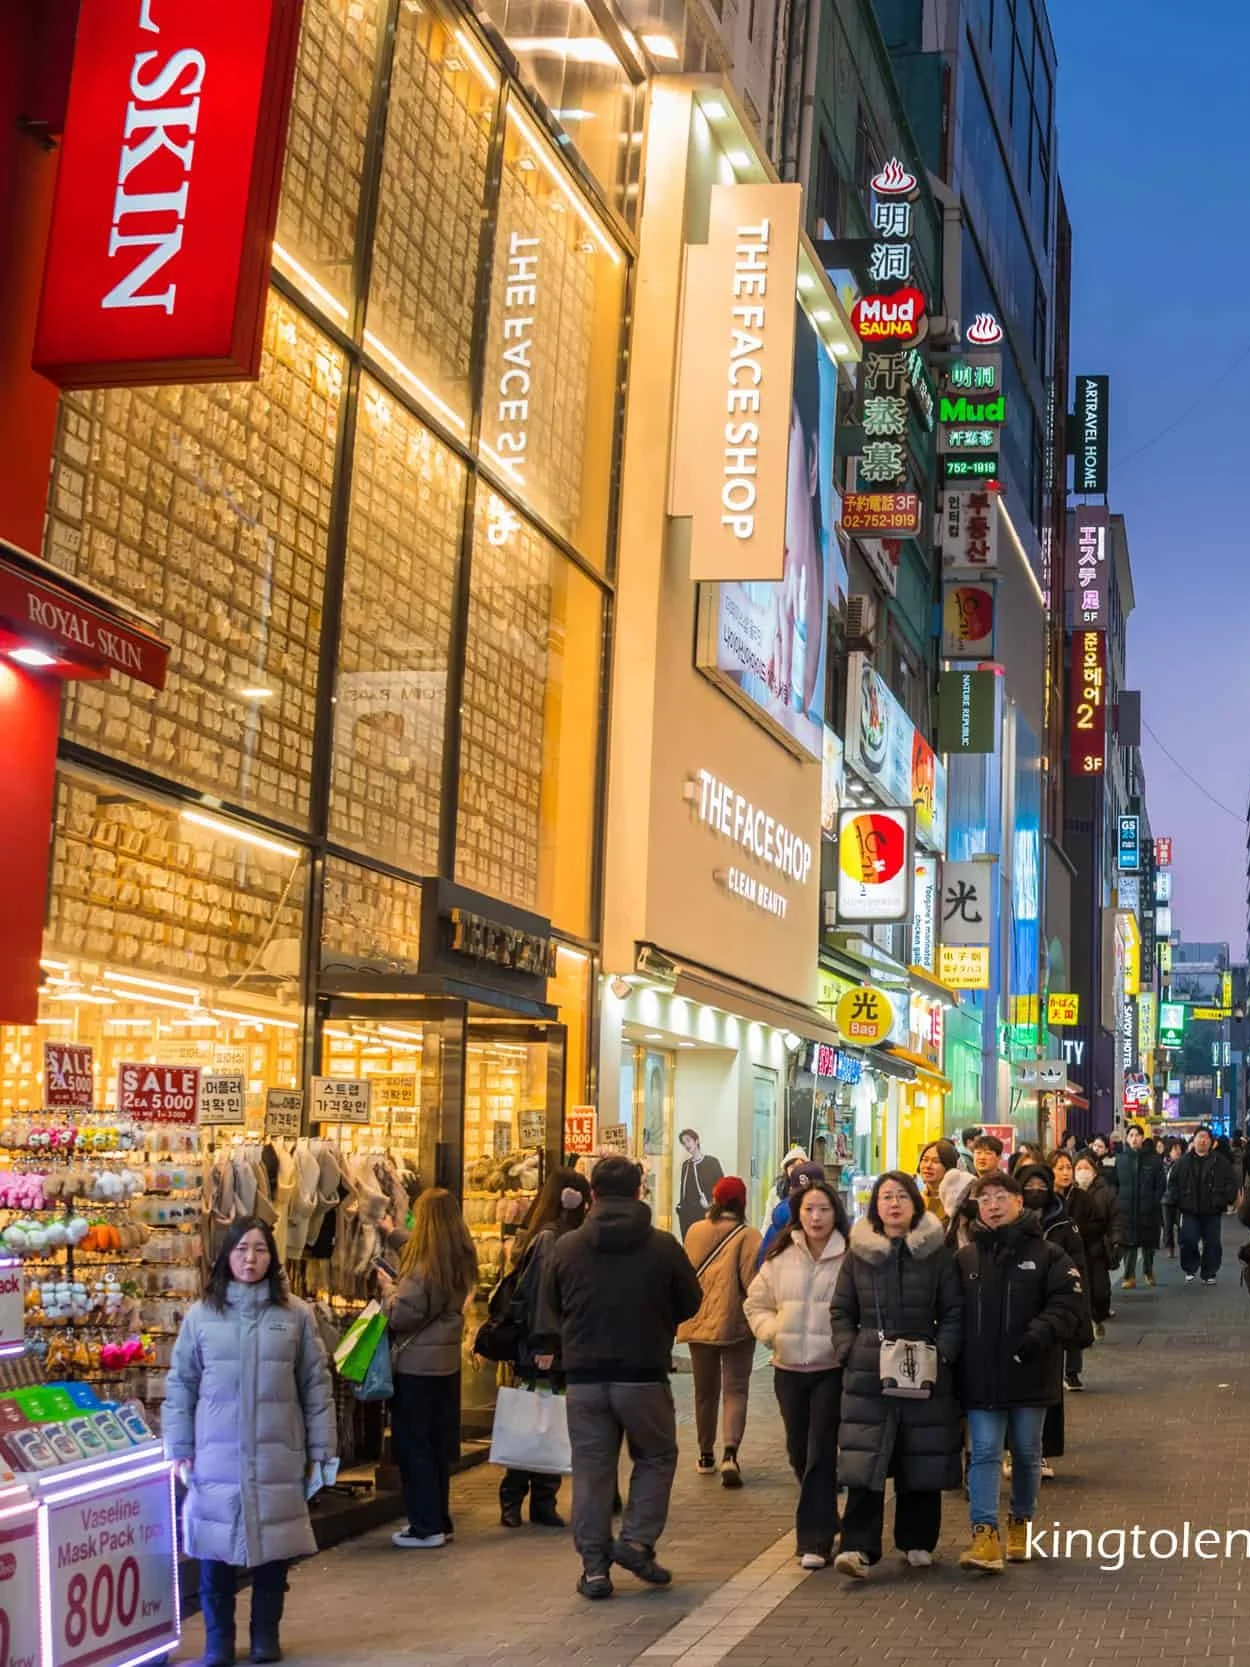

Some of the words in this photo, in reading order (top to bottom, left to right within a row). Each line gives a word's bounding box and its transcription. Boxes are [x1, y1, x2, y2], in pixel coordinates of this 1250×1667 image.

[102, 47, 207, 315] SKIN
[871, 202, 911, 281] 明洞
[731, 218, 771, 297] THE
[860, 298, 914, 322] Mud
[860, 321, 913, 336] SAUNA
[726, 306, 765, 415] FACE
[940, 397, 1005, 423] Mud
[1083, 379, 1098, 443] ARTRAVEL
[720, 421, 760, 541] SHOP
[947, 462, 996, 474] 752-1919
[1085, 446, 1098, 489] HOME
[895, 495, 915, 511] 3F
[843, 514, 916, 529] 02-752-1919
[966, 492, 991, 564] 부동산
[1083, 611, 1099, 623] 5F
[27, 592, 95, 648] ROYAL
[97, 628, 143, 672] SKIN
[1083, 632, 1102, 706] 준오헤어
[1076, 703, 1094, 729] 2
[1083, 756, 1103, 772] 3F
[699, 768, 734, 838] THE
[733, 794, 777, 863] FACE
[774, 823, 812, 885] SHOP
[1121, 820, 1136, 830] GS
[728, 866, 757, 904] CLEAN
[756, 883, 788, 920] BEAUTY
[943, 880, 983, 923] 光
[851, 992, 879, 1021] 光
[851, 1023, 877, 1036] Bag
[49, 1051, 92, 1075] SALE
[1123, 1038, 1133, 1068] HOTEL
[123, 1070, 195, 1095] SALE
[123, 1093, 148, 1108] 2EA
[201, 1098, 241, 1114] 격확인
[315, 1098, 368, 1115] 가격확인
[0, 1275, 20, 1295] ack
[80, 1499, 141, 1530] Vaseline
[57, 1536, 97, 1569] Mask
[99, 1526, 136, 1558] Pack
[64, 1556, 141, 1648] 800
[141, 1599, 162, 1618] krw
